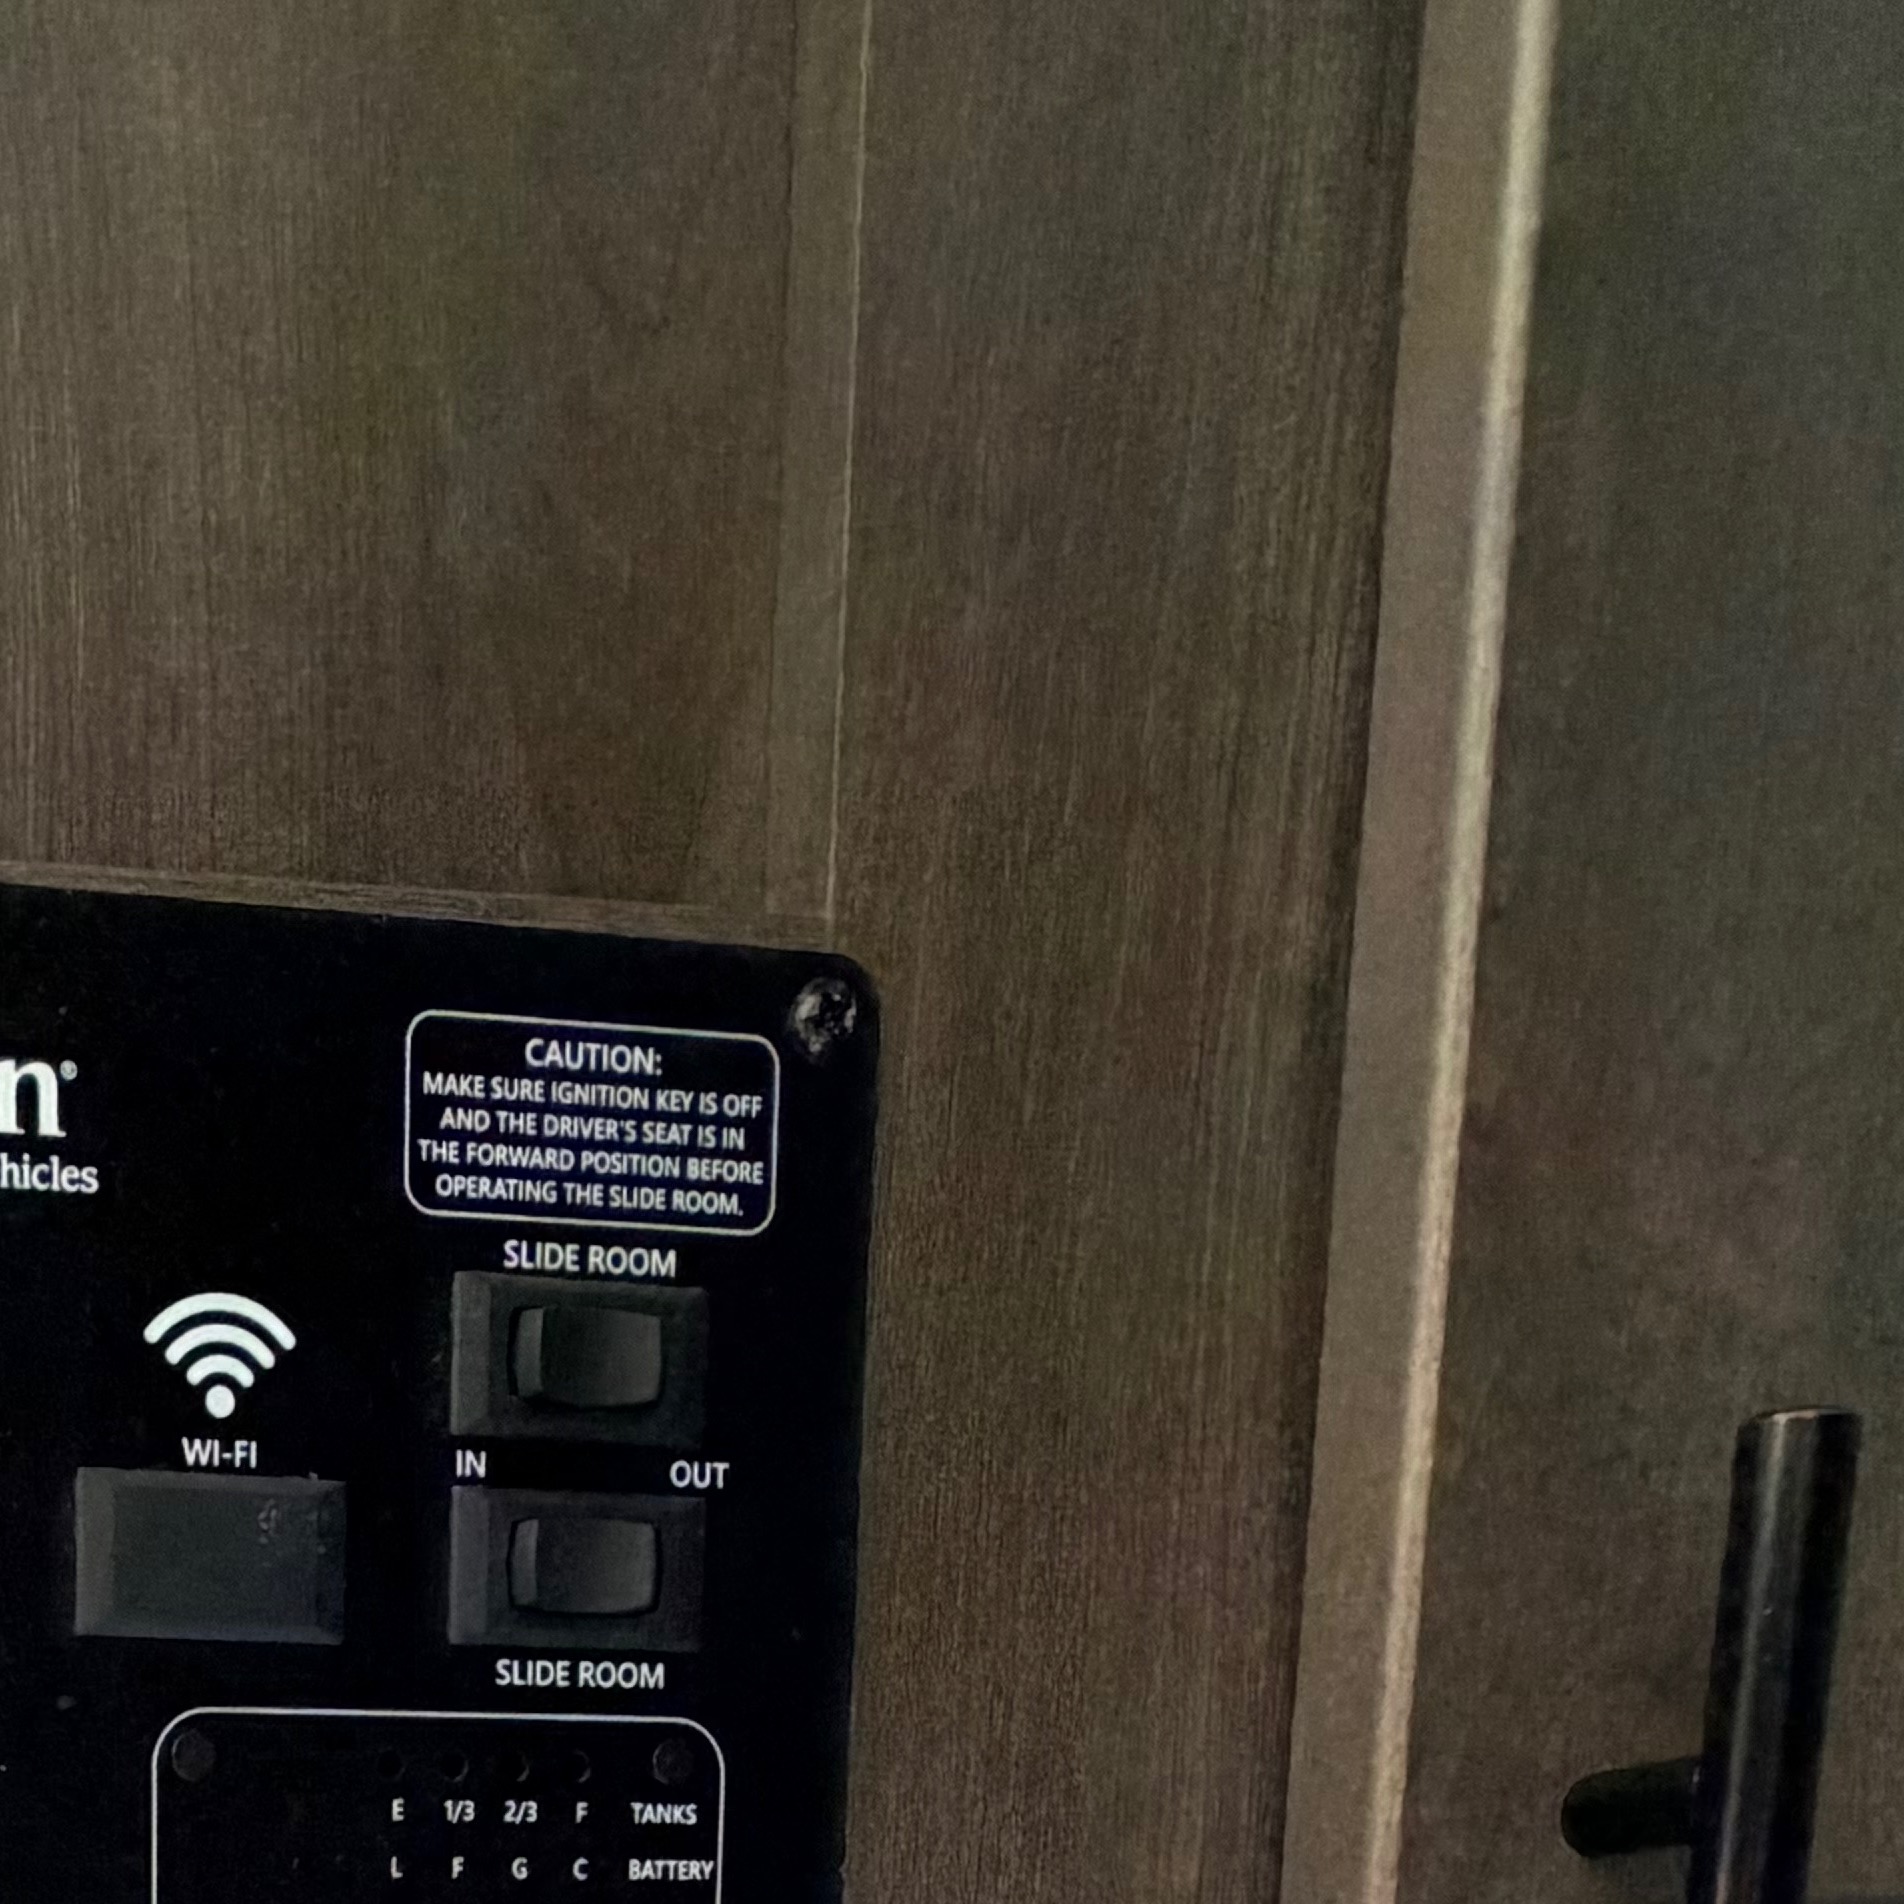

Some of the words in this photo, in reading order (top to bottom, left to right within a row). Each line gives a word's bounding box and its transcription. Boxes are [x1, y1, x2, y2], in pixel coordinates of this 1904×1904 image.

[524, 1037, 663, 1076] CAUTION:
[422, 1070, 486, 1099] MAKE
[490, 1075, 546, 1103] SURE
[550, 1080, 650, 1110] IGNITION
[655, 1089, 695, 1113] KEY
[698, 1091, 719, 1116] IS
[722, 1093, 763, 1119] OFF
[439, 1106, 491, 1133] AND
[495, 1110, 538, 1136] THE
[543, 1113, 638, 1143] DRIVER'S
[642, 1120, 693, 1146] SEAT
[696, 1124, 717, 1149] IS
[721, 1127, 745, 1151] IN
[417, 1138, 460, 1165] THE
[466, 1141, 576, 1172] FORWARD
[580, 1150, 681, 1179] POSITION
[686, 1157, 764, 1186] BEFORE
[435, 1173, 558, 1204] OPERATING
[562, 1182, 604, 1208] THE
[608, 1184, 667, 1211] SLIDE
[671, 1188, 744, 1217] ROOM.
[503, 1238, 580, 1272] SLIDE
[587, 1244, 677, 1278] ROOM
[181, 1436, 258, 1469] WI-FI
[456, 1449, 487, 1478] IN
[669, 1459, 730, 1489] OUT
[495, 1658, 571, 1688] SLIDE
[578, 1660, 665, 1690] ROOM
[391, 1797, 404, 1822] E
[443, 1799, 476, 1824] 1/3
[503, 1799, 538, 1825] 2/3
[575, 1801, 588, 1824] F
[630, 1802, 698, 1826] TANKS
[390, 1856, 404, 1879] L
[451, 1856, 465, 1879] F
[511, 1856, 528, 1880] G
[572, 1856, 589, 1881] C
[628, 1858, 715, 1881] BATTERY
